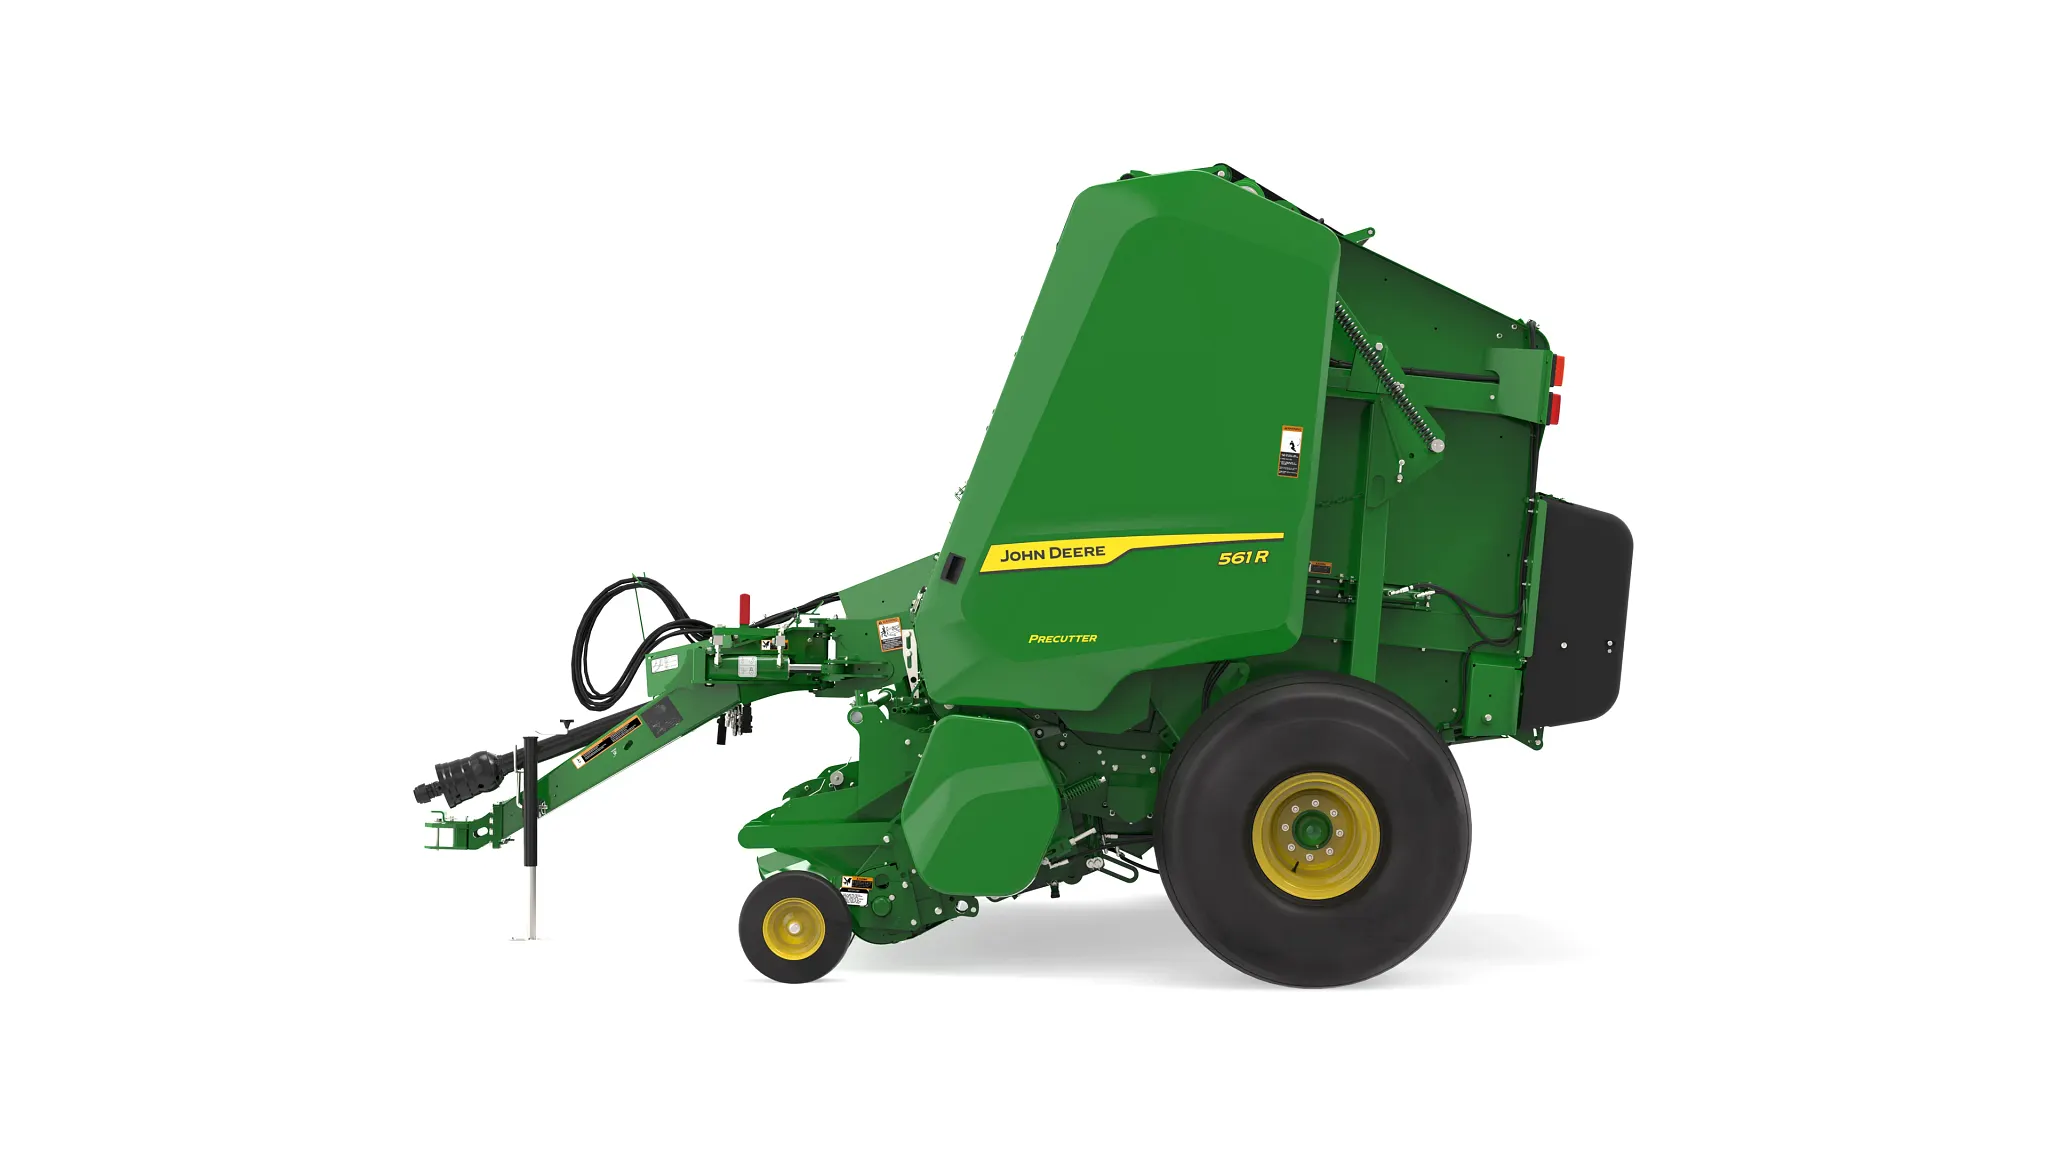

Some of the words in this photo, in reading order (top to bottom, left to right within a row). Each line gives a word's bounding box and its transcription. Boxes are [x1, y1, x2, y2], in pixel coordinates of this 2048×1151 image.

[1000, 549, 1046, 563] JOHN
[1049, 545, 1106, 560] DEERE
[1217, 551, 1253, 566] 561
[1028, 634, 1098, 644] PRECUTTER
